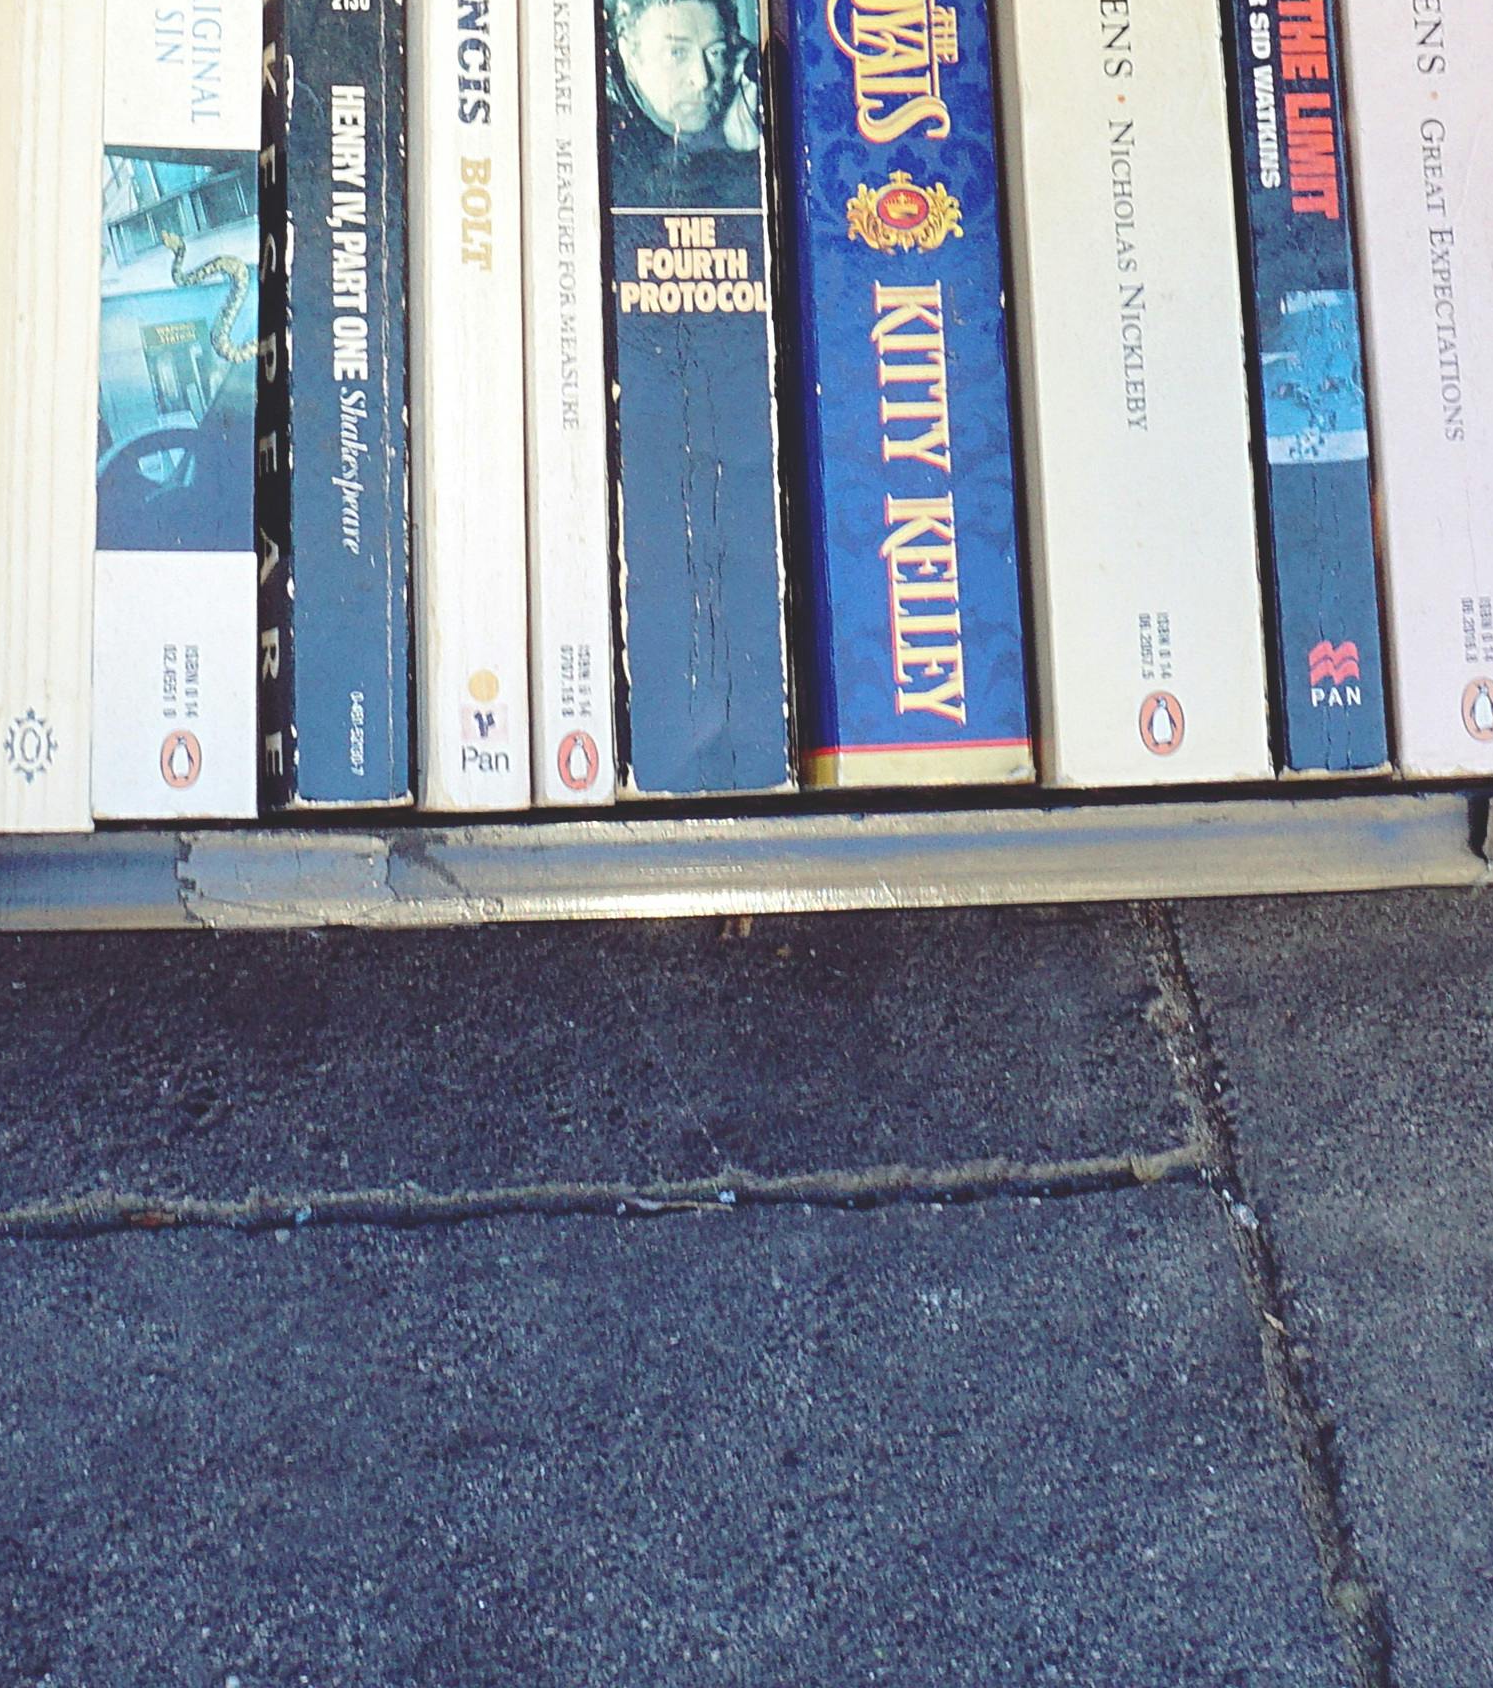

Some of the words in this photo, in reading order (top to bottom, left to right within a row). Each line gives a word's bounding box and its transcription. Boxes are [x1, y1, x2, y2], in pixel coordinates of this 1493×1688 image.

[154, 9, 184, 65] SIN
[1249, 13, 1272, 60] SID
[331, 85, 366, 188] HENRY
[1251, 65, 1281, 190] WATKINS
[1284, 82, 1340, 219] LIMIT
[1419, 118, 1447, 214] GREAT
[460, 157, 492, 273] BOLT
[555, 138, 576, 255] MEASURE
[665, 217, 717, 248] THE
[1108, 119, 1137, 273] NICHOLAS
[332, 231, 367, 313] PART
[558, 260, 577, 306] FOR
[620, 279, 767, 313] PROTOCOL
[636, 248, 748, 280] FOURTH
[333, 319, 369, 381] ONE
[559, 313, 580, 430] MEASURE
[871, 280, 951, 472] KITTY
[1118, 283, 1148, 432] NICKLEBY
[1429, 224, 1465, 443] EXPECTATIONS
[330, 386, 369, 555] Shakespeare
[881, 491, 967, 727] KELLEY
[1311, 685, 1361, 707] PAN
[461, 747, 509, 773] Pan
